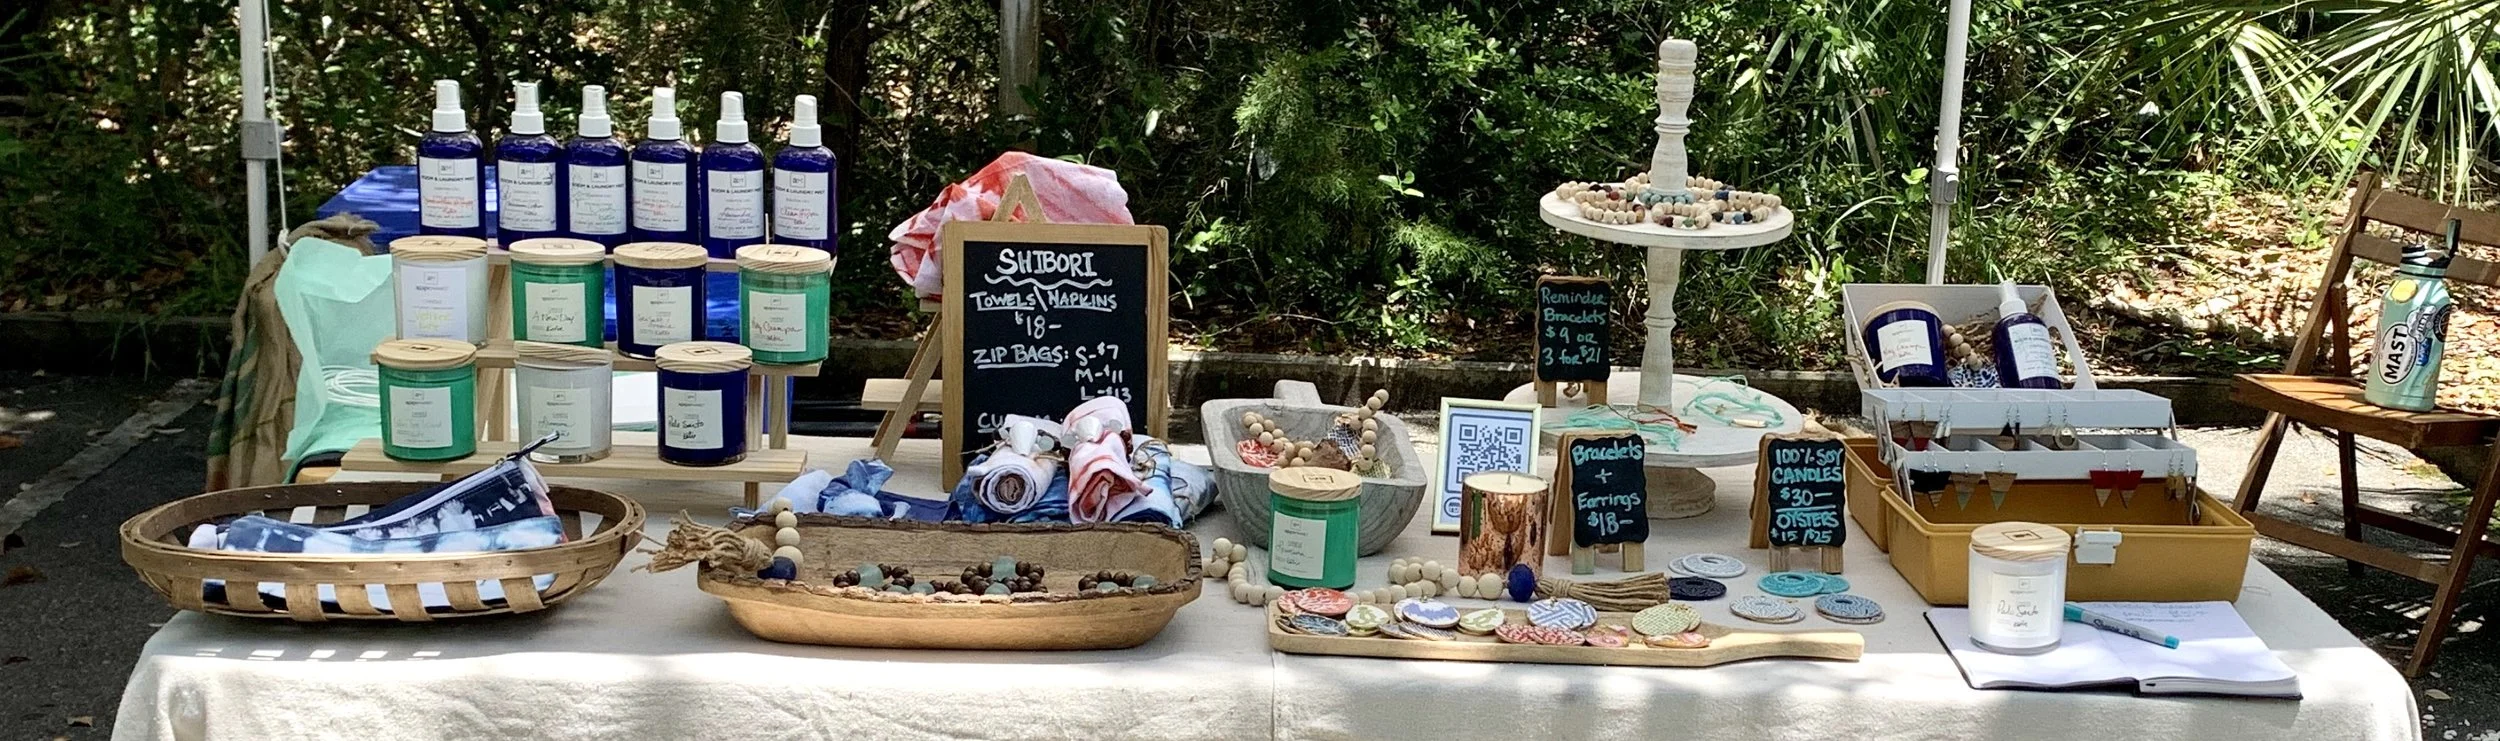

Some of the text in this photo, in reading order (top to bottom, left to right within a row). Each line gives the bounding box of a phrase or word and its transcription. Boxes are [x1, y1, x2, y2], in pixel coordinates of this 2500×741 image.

[996, 248, 1098, 277] SHIBORI
[1543, 307, 1607, 326] Bracelets
[973, 348, 1005, 365] ZIP
[1011, 344, 1069, 365] BAGS:
[1542, 347, 1554, 366] 3
[1579, 345, 1602, 364] $21
[2383, 327, 2408, 381] MAST
[1571, 439, 1644, 466] Bracelets
[1775, 447, 1844, 466] 100% SOY
[1594, 467, 1613, 485] +
[1771, 466, 1843, 485] CANDLES
[1577, 491, 1641, 512] Earrings
[1776, 510, 1840, 530] OYSTERS
